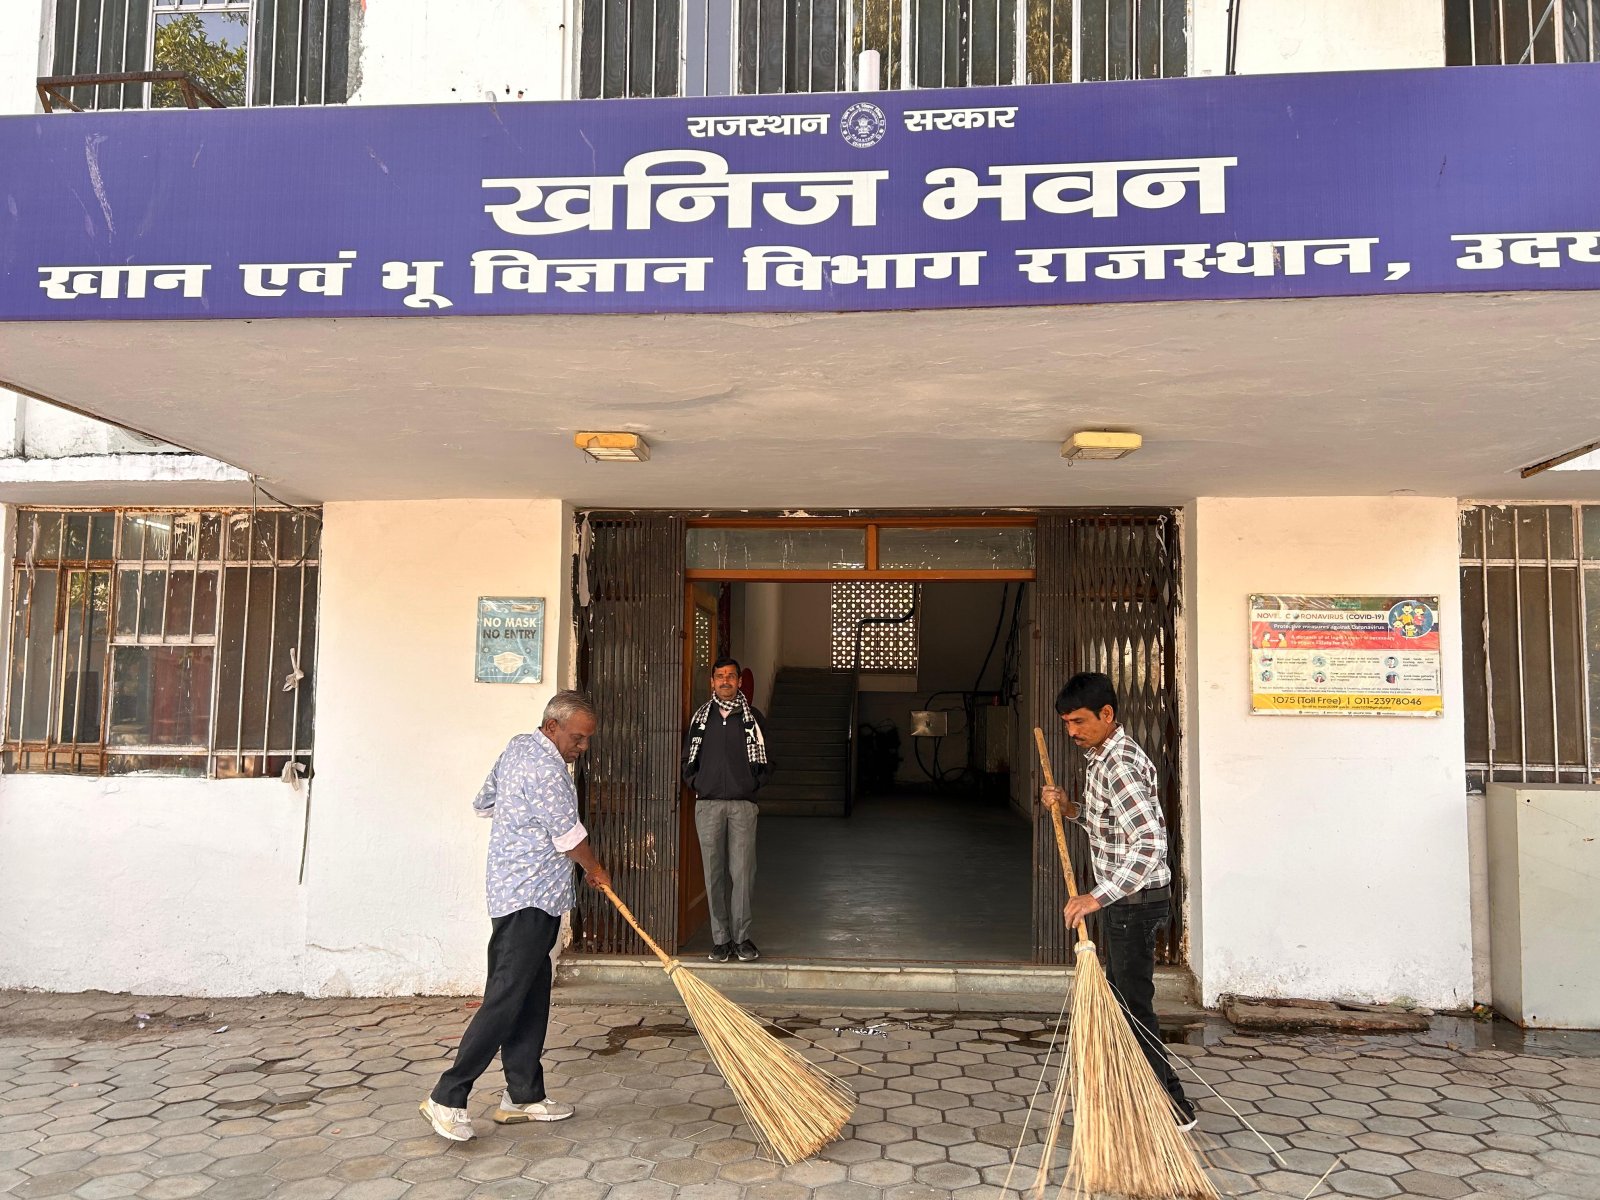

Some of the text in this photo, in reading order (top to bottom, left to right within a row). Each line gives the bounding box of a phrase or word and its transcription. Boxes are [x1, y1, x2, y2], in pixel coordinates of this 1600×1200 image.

[687, 113, 830, 138] राजस्थान
[904, 107, 1018, 132] सरकार
[482, 149, 1238, 235] खनिज भवन
[38, 264, 212, 300] खान
[239, 250, 357, 297] एवं
[382, 261, 454, 309] भू
[470, 249, 714, 294] विज्ञान
[743, 245, 988, 291] विभाग
[1015, 237, 1411, 284] राजस्थान,
[483, 617, 537, 628] NO MASK
[1346, 613, 1385, 621] (COVID-19)
[482, 629, 537, 640] NO ENTRY
[1272, 696, 1296, 704] 1075
[1297, 696, 1316, 705] (Toll
[1317, 697, 1342, 705] Free)
[1354, 697, 1422, 705] 011-23978046
